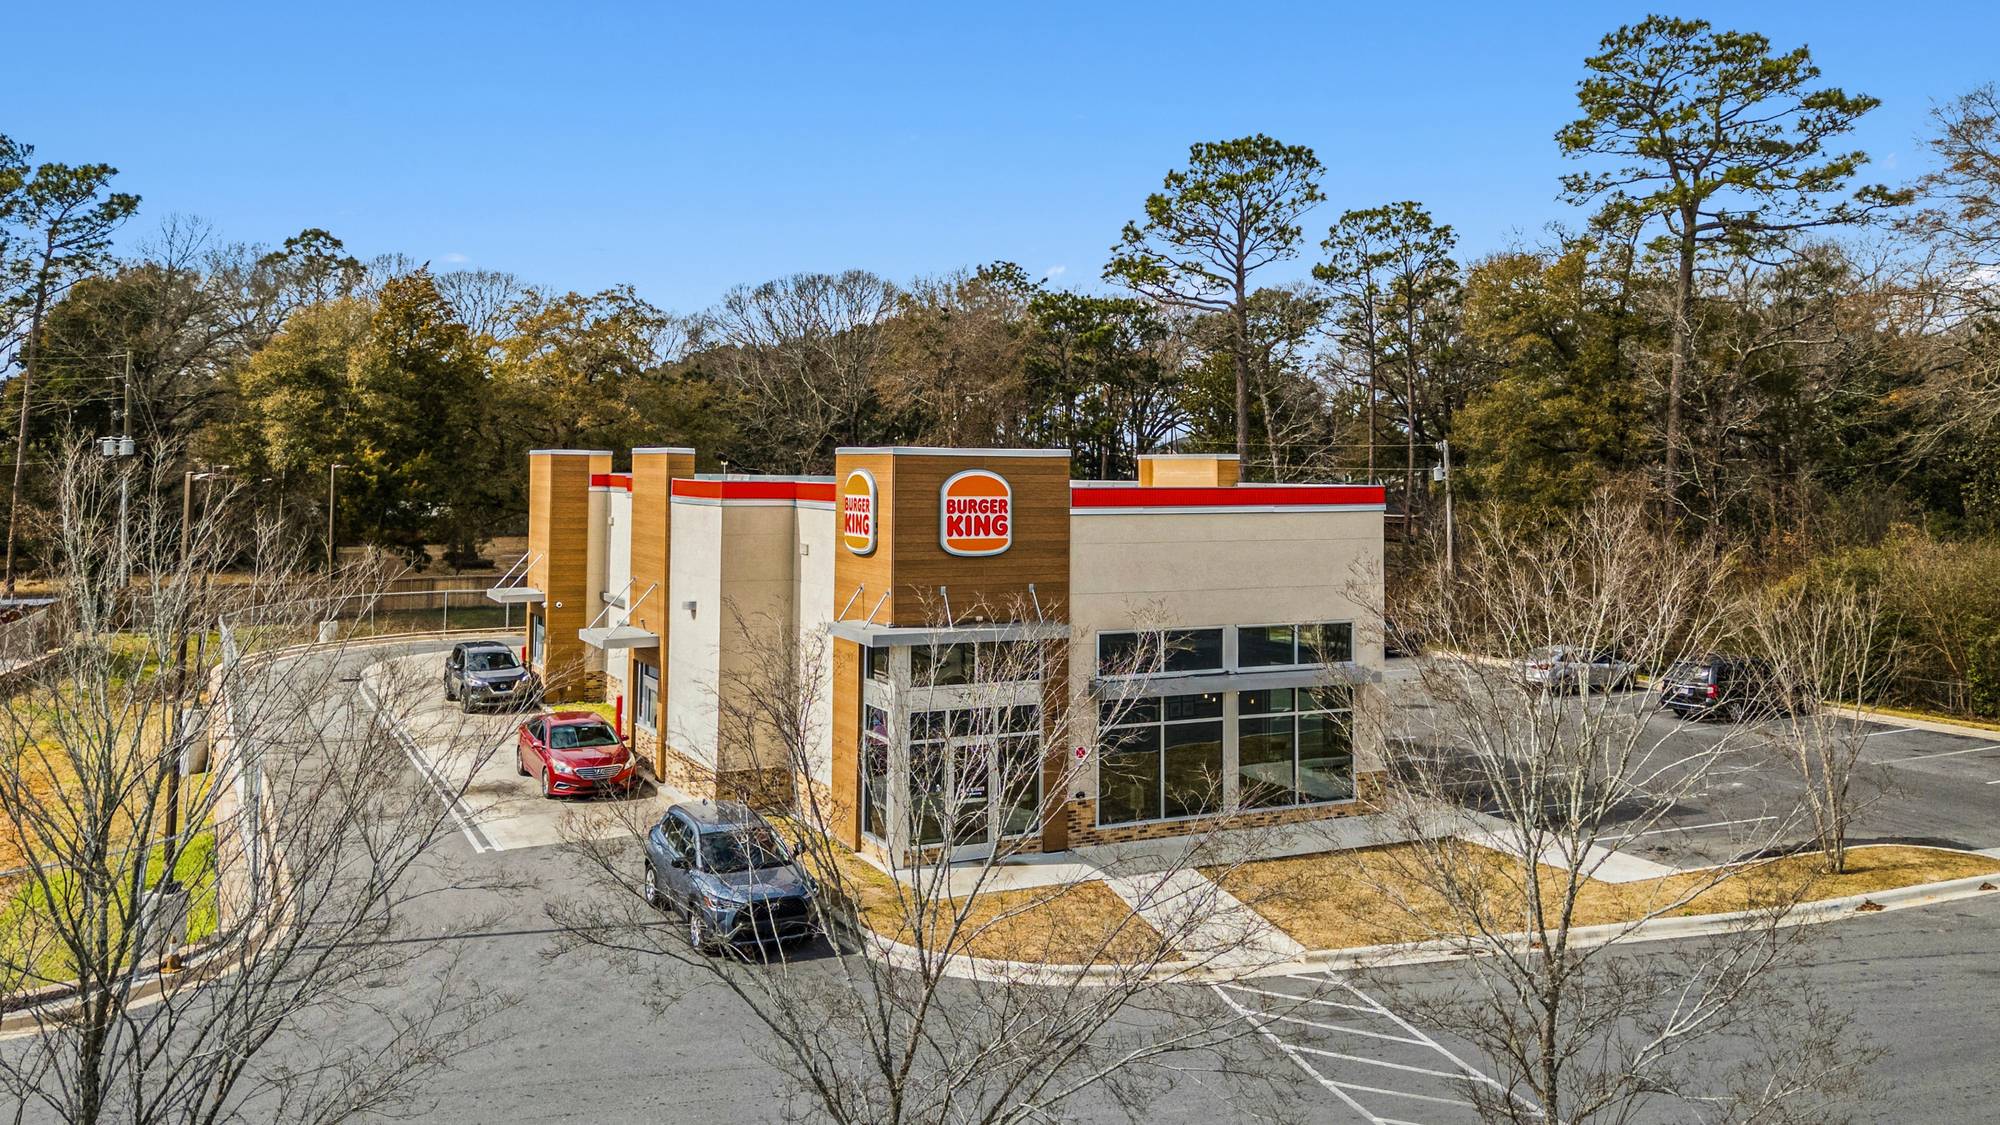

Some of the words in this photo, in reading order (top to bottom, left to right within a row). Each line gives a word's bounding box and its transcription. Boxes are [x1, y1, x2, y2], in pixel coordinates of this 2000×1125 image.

[844, 497, 870, 513] BURGER
[946, 499, 1009, 515] BURGER
[844, 513, 870, 535] KING
[946, 515, 1009, 537] KING
